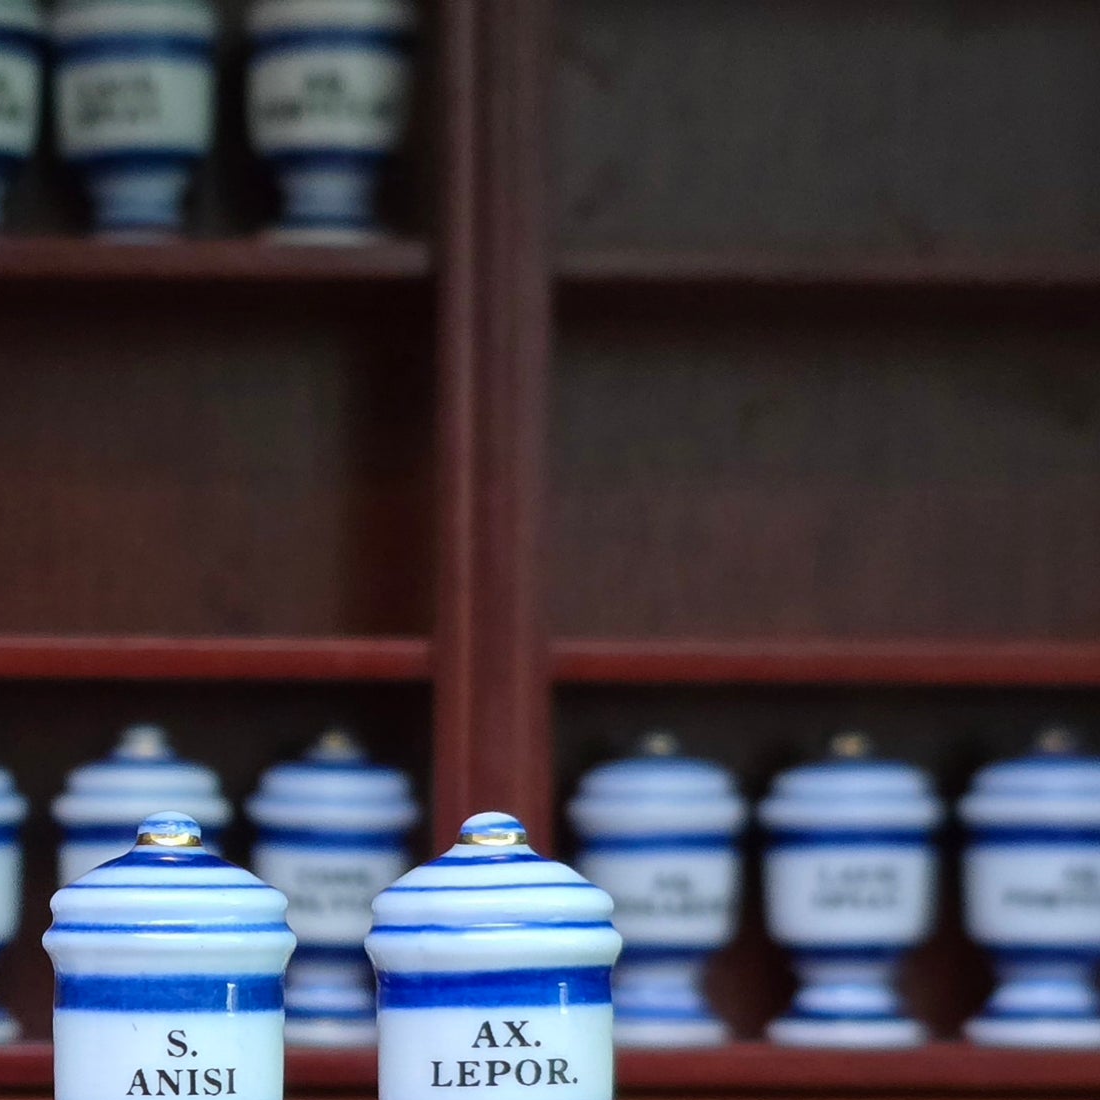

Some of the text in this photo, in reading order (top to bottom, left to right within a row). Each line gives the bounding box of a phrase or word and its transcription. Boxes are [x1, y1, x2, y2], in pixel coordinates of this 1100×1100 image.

[167, 1030, 198, 1058] S.
[471, 1020, 541, 1048] AX.
[126, 1067, 236, 1096] ANISI
[431, 1058, 578, 1087] LEPOR.
